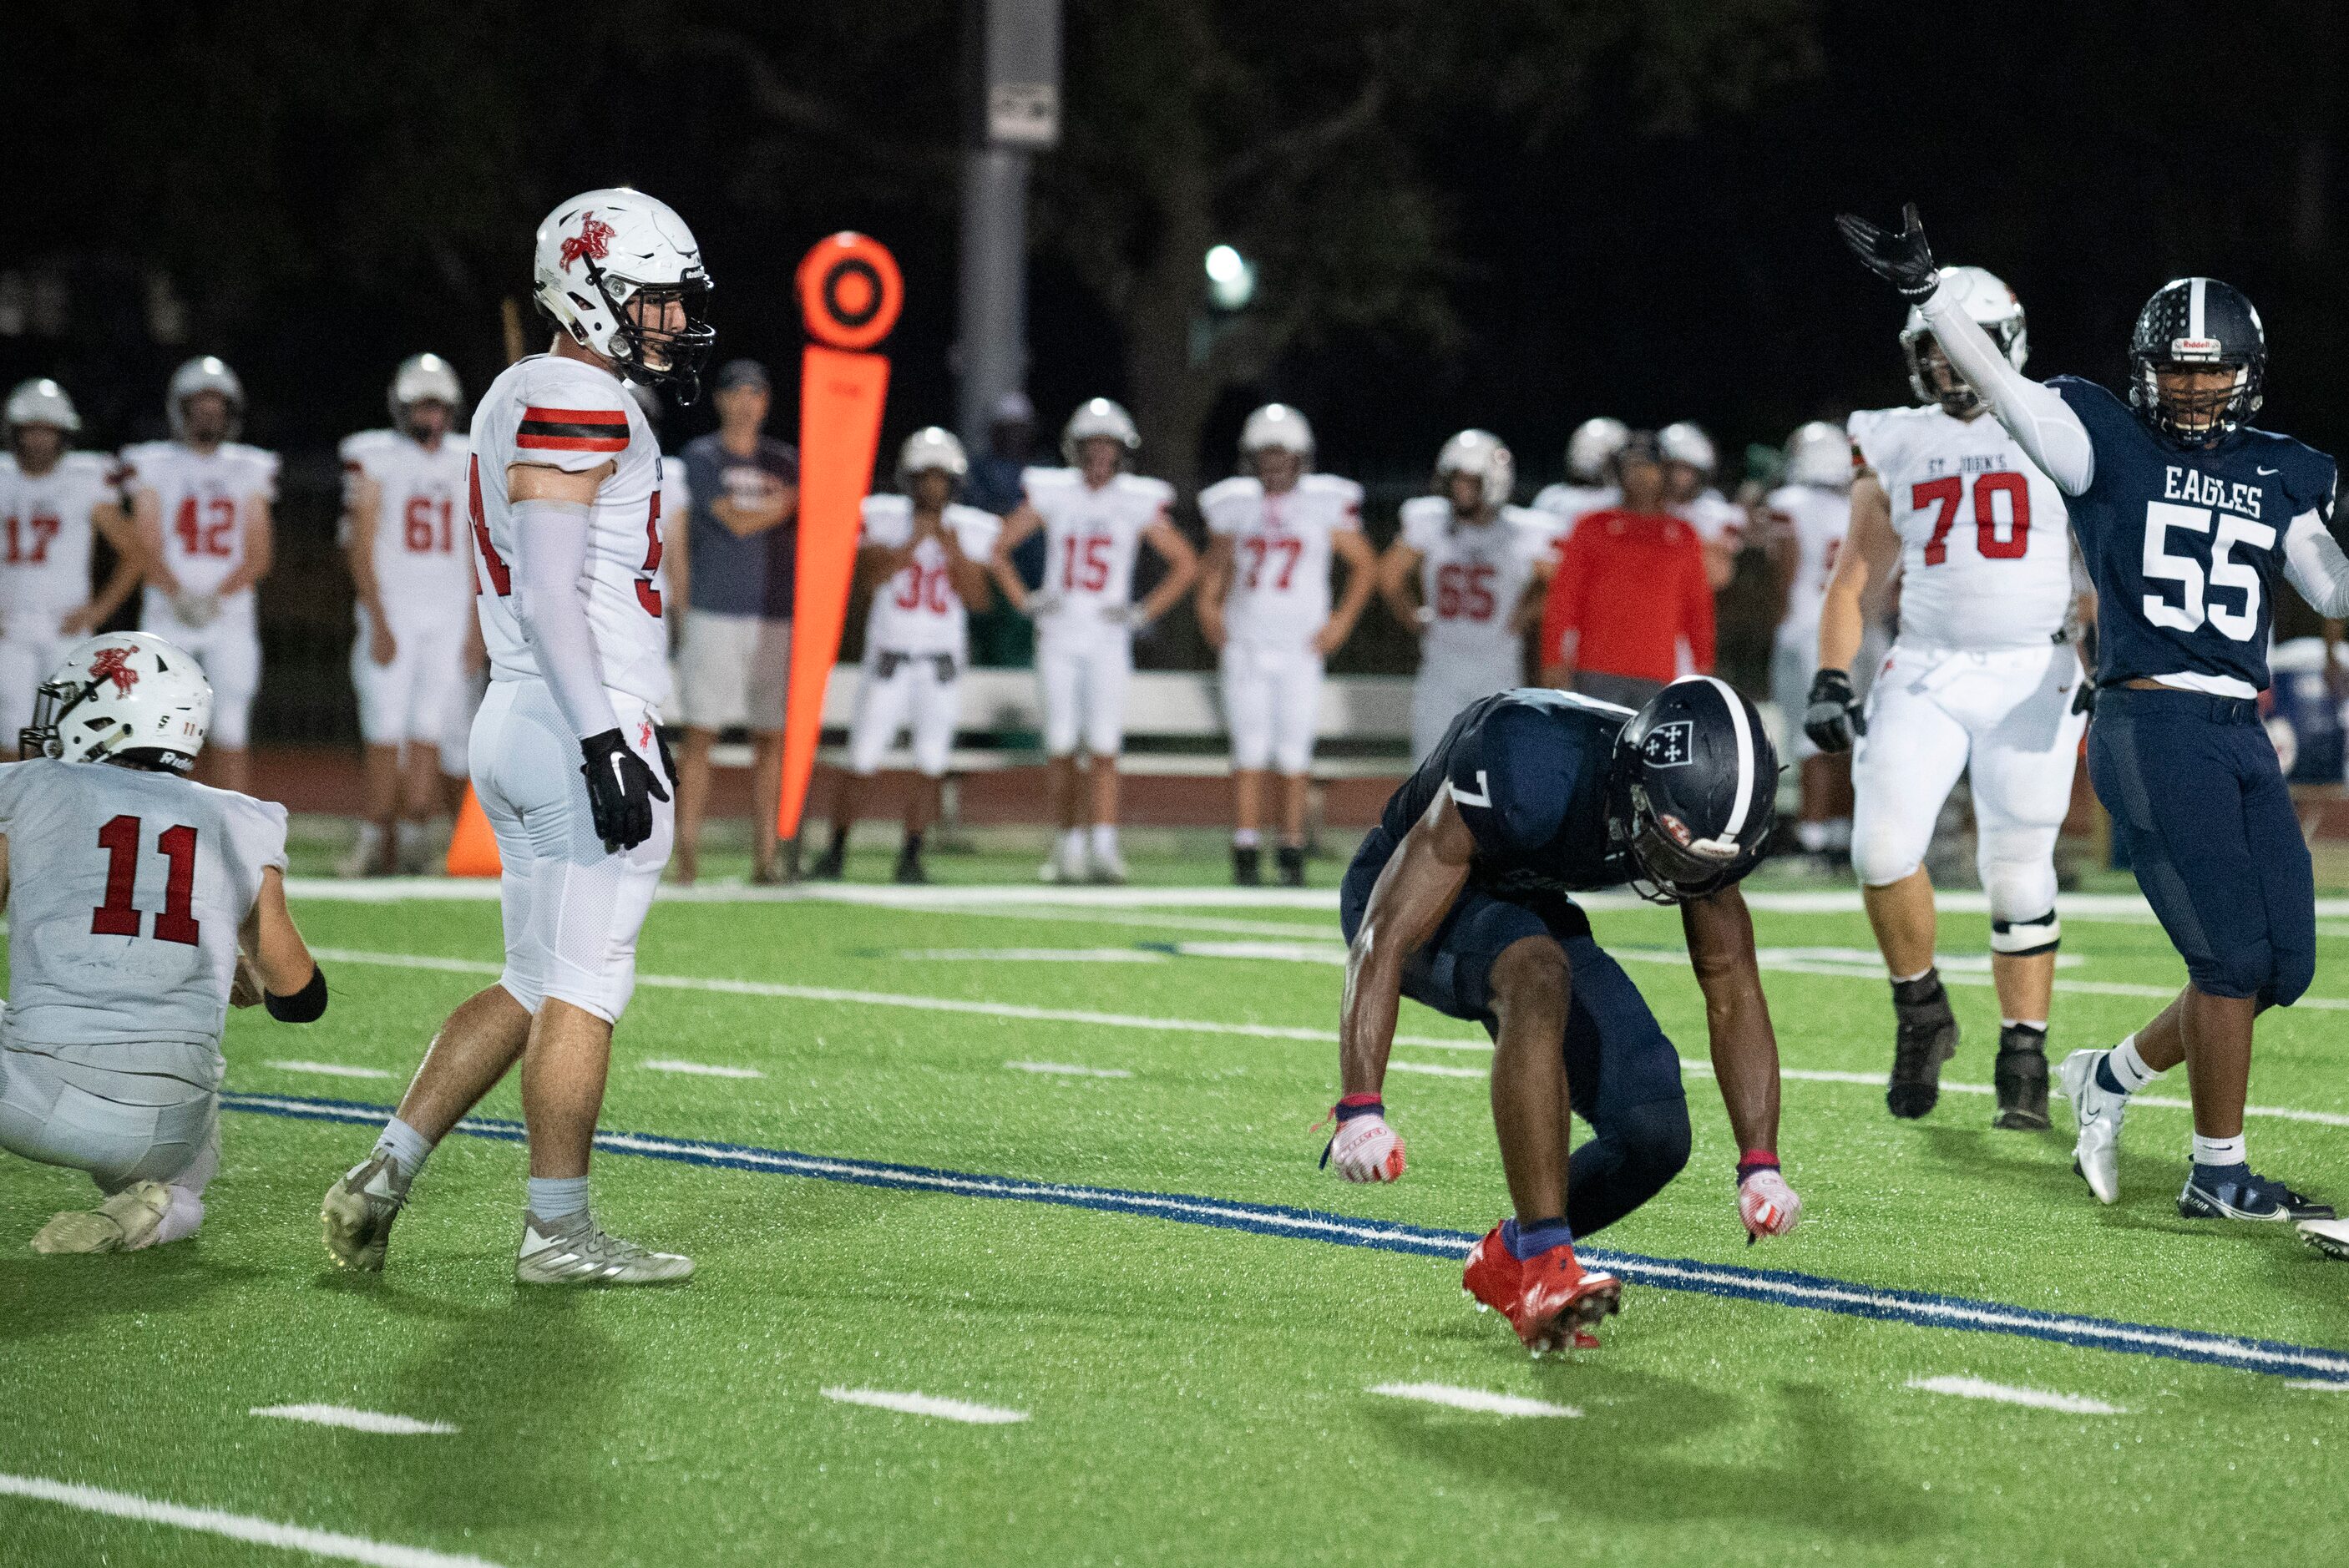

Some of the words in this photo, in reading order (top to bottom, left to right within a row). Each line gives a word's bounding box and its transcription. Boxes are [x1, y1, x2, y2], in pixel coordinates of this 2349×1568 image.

[2183, 340, 2210, 348] Riddell
[1911, 472, 2031, 567] 70
[2164, 465, 2262, 519] EAGLES
[5, 515, 61, 566] 17
[175, 496, 234, 558] 42
[404, 496, 453, 554] 61
[1063, 535, 1113, 591] 15
[1243, 535, 1304, 590] 77
[2143, 500, 2277, 642] 55
[1437, 562, 1497, 621] 65
[1447, 770, 1493, 808] 7
[91, 814, 200, 948] 11
